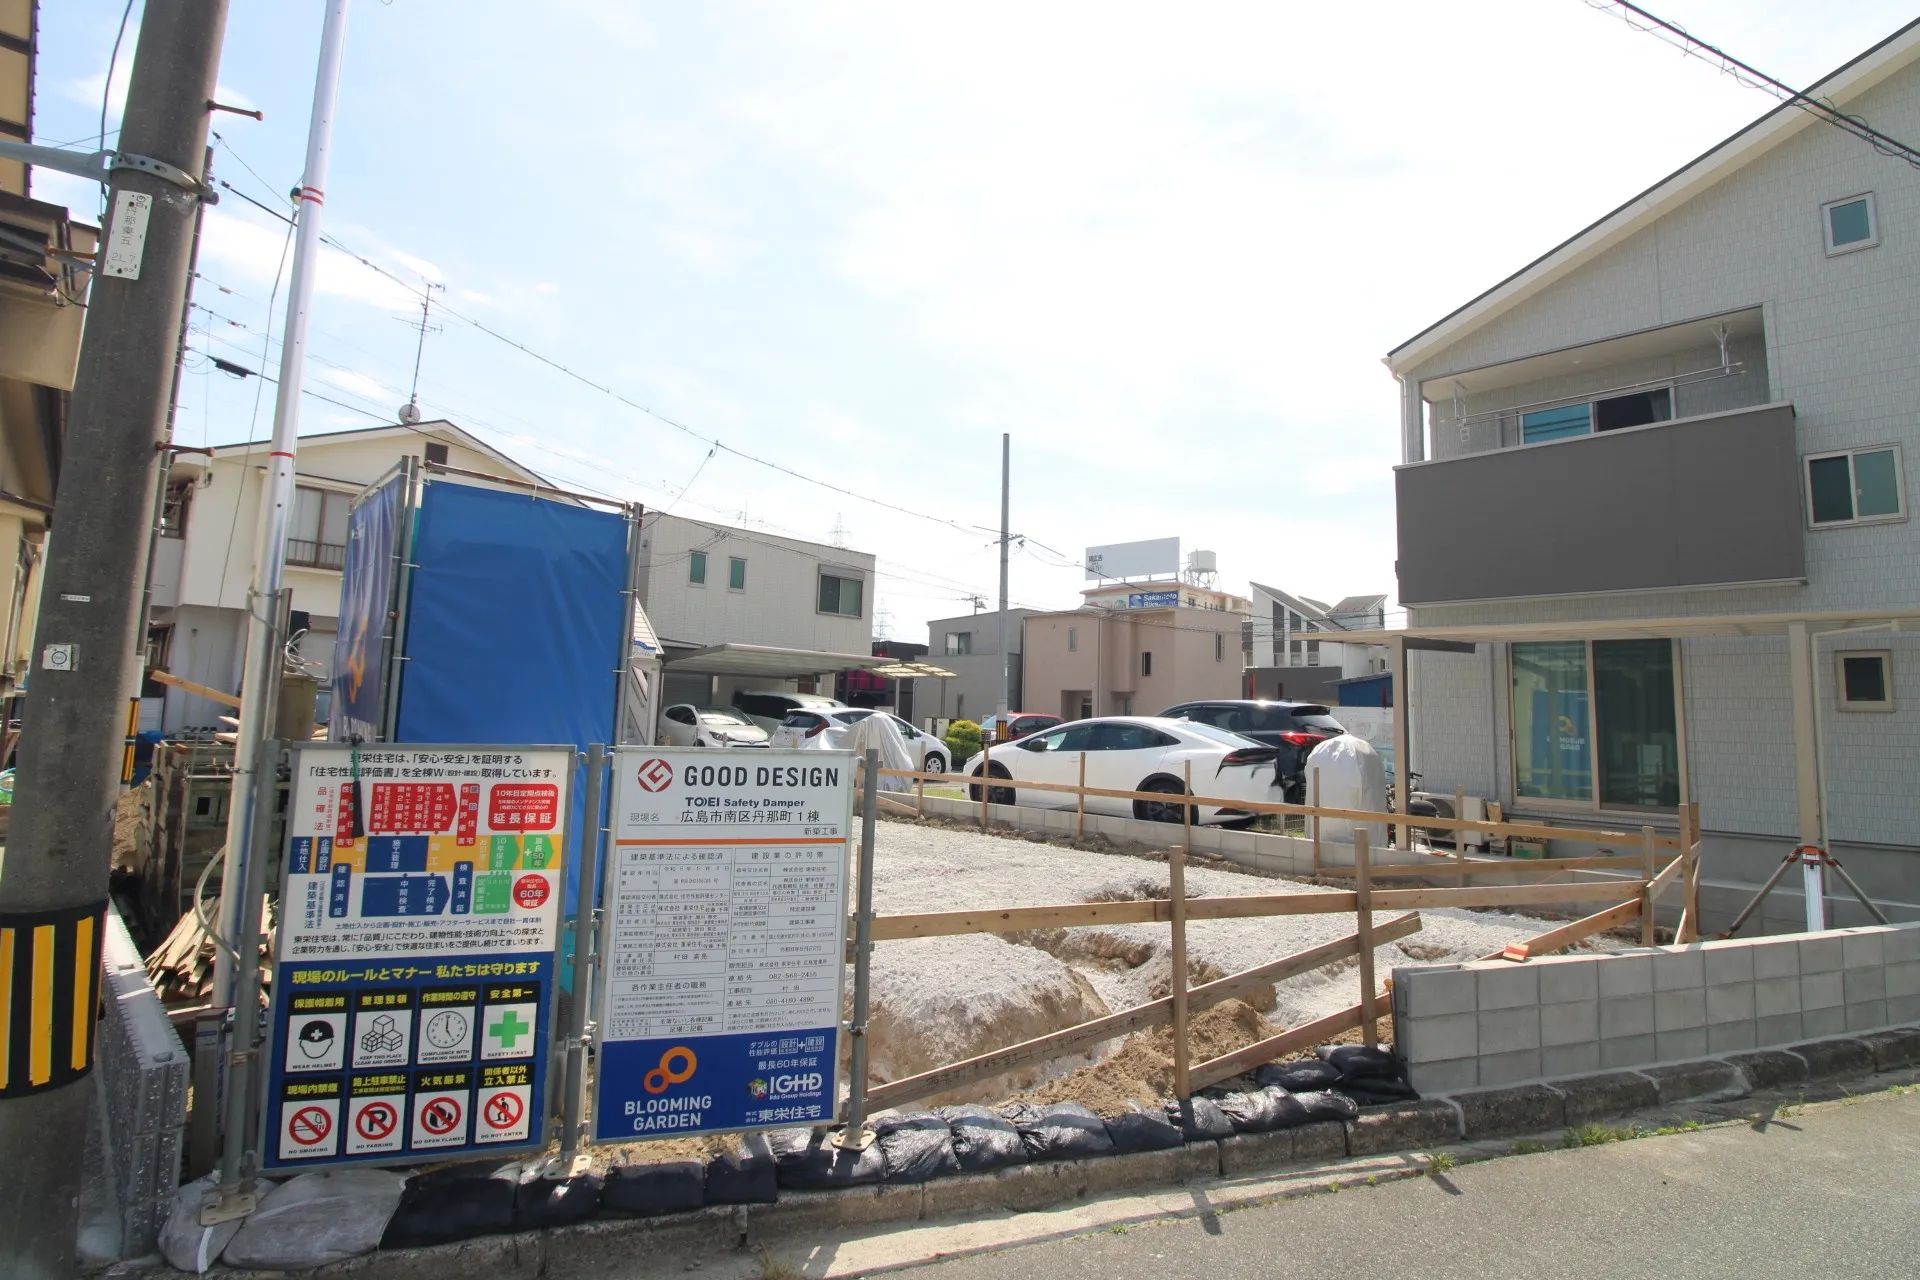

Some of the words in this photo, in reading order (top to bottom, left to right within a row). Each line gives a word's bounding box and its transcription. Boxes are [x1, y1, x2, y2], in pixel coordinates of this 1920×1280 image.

[684, 765, 748, 787] GOOD
[757, 766, 839, 788] DESIGN
[724, 798, 759, 809] Safety
[763, 799, 806, 809] Damper
[493, 812, 552, 824] 延長保証
[630, 813, 660, 822] 現場名
[804, 827, 838, 836] 新築工事
[298, 840, 310, 871] 土地仕入
[390, 839, 401, 869] 施工管理
[630, 852, 724, 861] 建築基準法による確認済
[751, 852, 824, 860] 建設業の許可票
[333, 865, 347, 916] 確認済証
[456, 863, 468, 912] 検査済証
[398, 880, 409, 914] 中間検査
[425, 879, 437, 912] 完了検査
[520, 890, 544, 898] 60年
[304, 881, 318, 929] 建築基準法
[292, 966, 432, 984] 現場のルールとマナー
[436, 961, 541, 978] 私たちは守ります
[631, 981, 707, 992] 各作業主任者の職務
[362, 994, 408, 1005] 整理整頓
[490, 988, 533, 999] 安全第一
[294, 997, 345, 1008] 保護帽着用
[727, 999, 752, 1007] 連絡先
[750, 1040, 778, 1049] ダブルの
[780, 1040, 797, 1048] 設計
[807, 1038, 823, 1046] 建設
[749, 1048, 777, 1056] 性能評価
[758, 1056, 818, 1071] 最長60年保証
[484, 1065, 527, 1076] 関係者以外
[421, 1074, 466, 1087] 火気厳禁
[483, 1075, 527, 1086] 立入禁止
[769, 1072, 823, 1094] IGHD
[624, 1095, 712, 1115] BLOOMING
[758, 1104, 821, 1122] 東栄住宅
[633, 1112, 701, 1131] GARDEN
